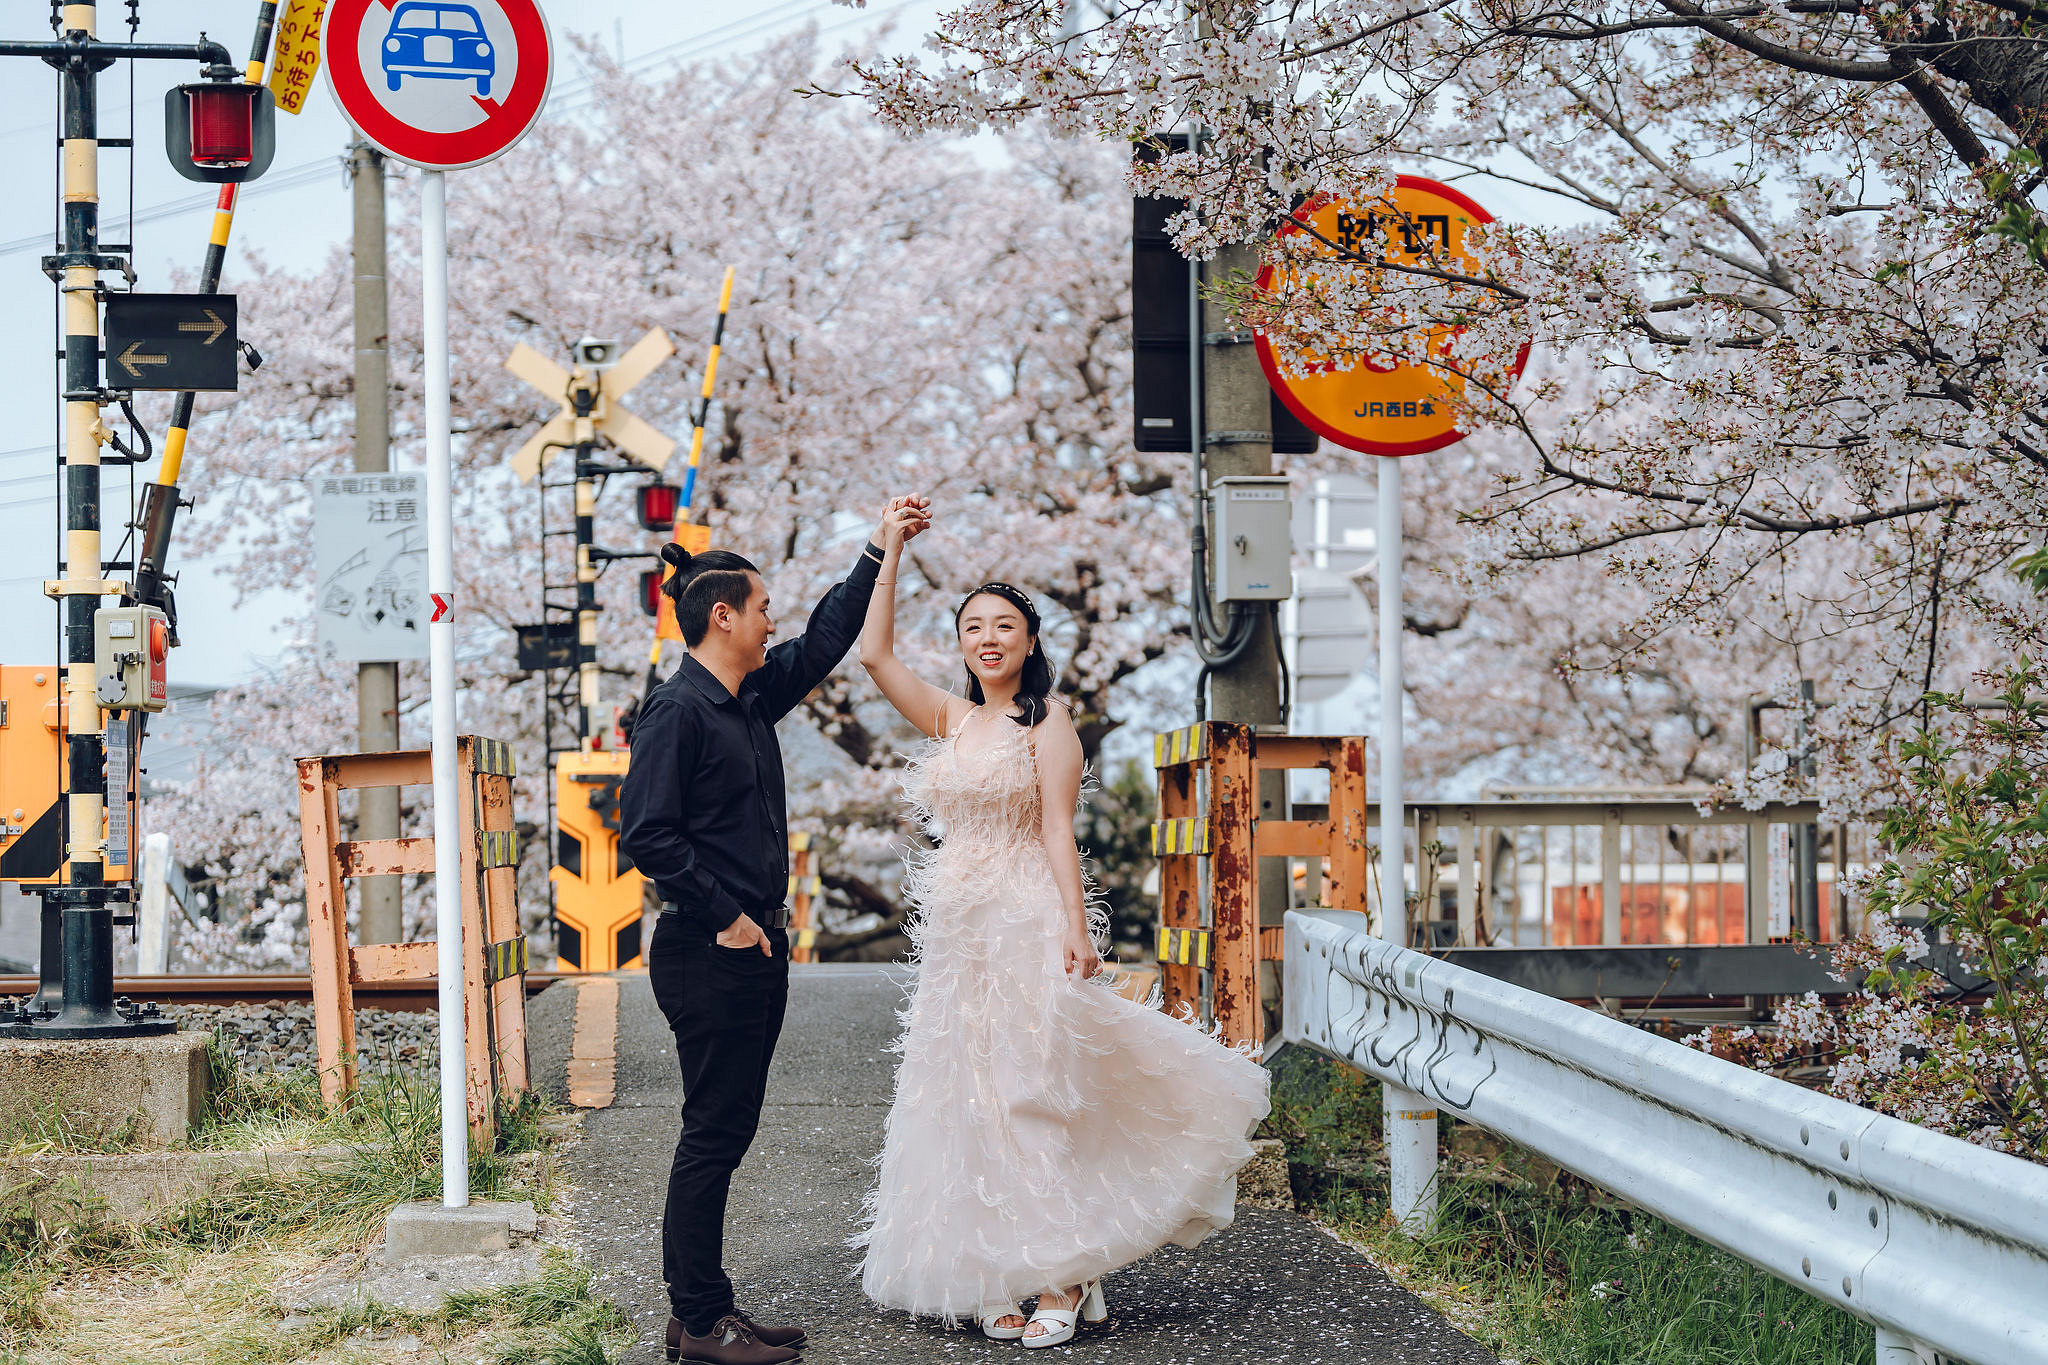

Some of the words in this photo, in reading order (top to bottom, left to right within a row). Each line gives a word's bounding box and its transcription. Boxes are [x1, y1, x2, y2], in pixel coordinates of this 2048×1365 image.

[1354, 401, 1436, 417] JR西日本
[366, 499, 418, 522] 注意
